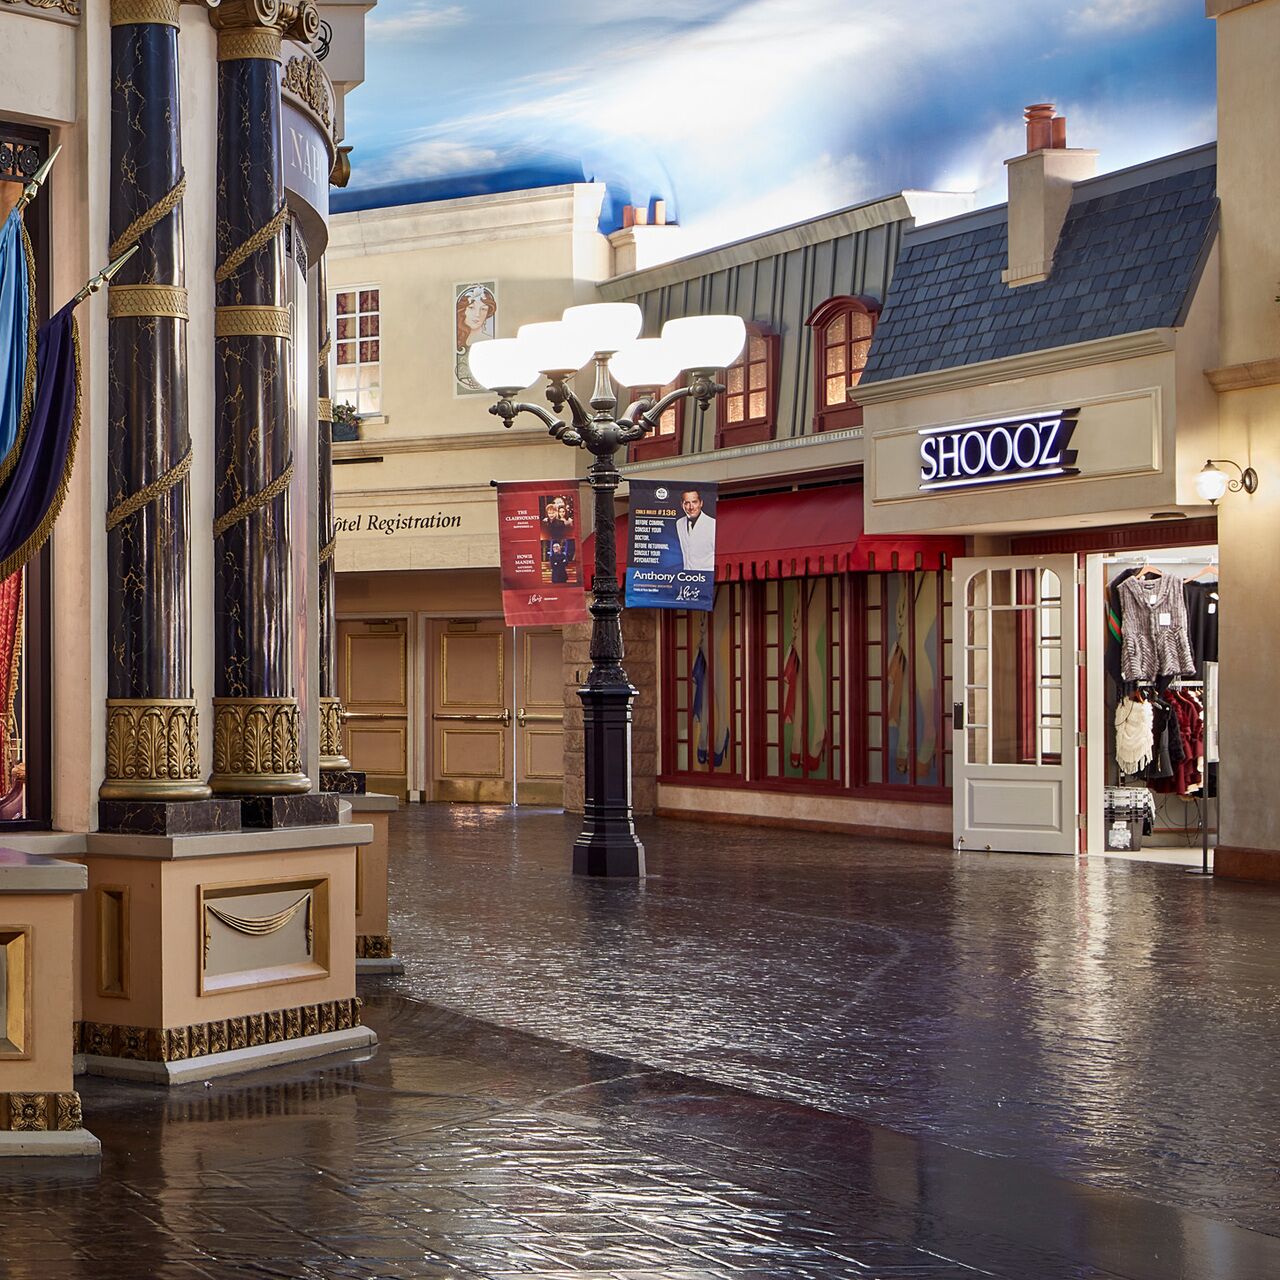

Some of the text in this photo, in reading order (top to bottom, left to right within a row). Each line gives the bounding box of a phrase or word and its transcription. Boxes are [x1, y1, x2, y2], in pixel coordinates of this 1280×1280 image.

[920, 419, 1062, 481] SHOOOZ
[333, 511, 462, 535] ôtel Registration
[633, 570, 706, 583] Anthony Cools
